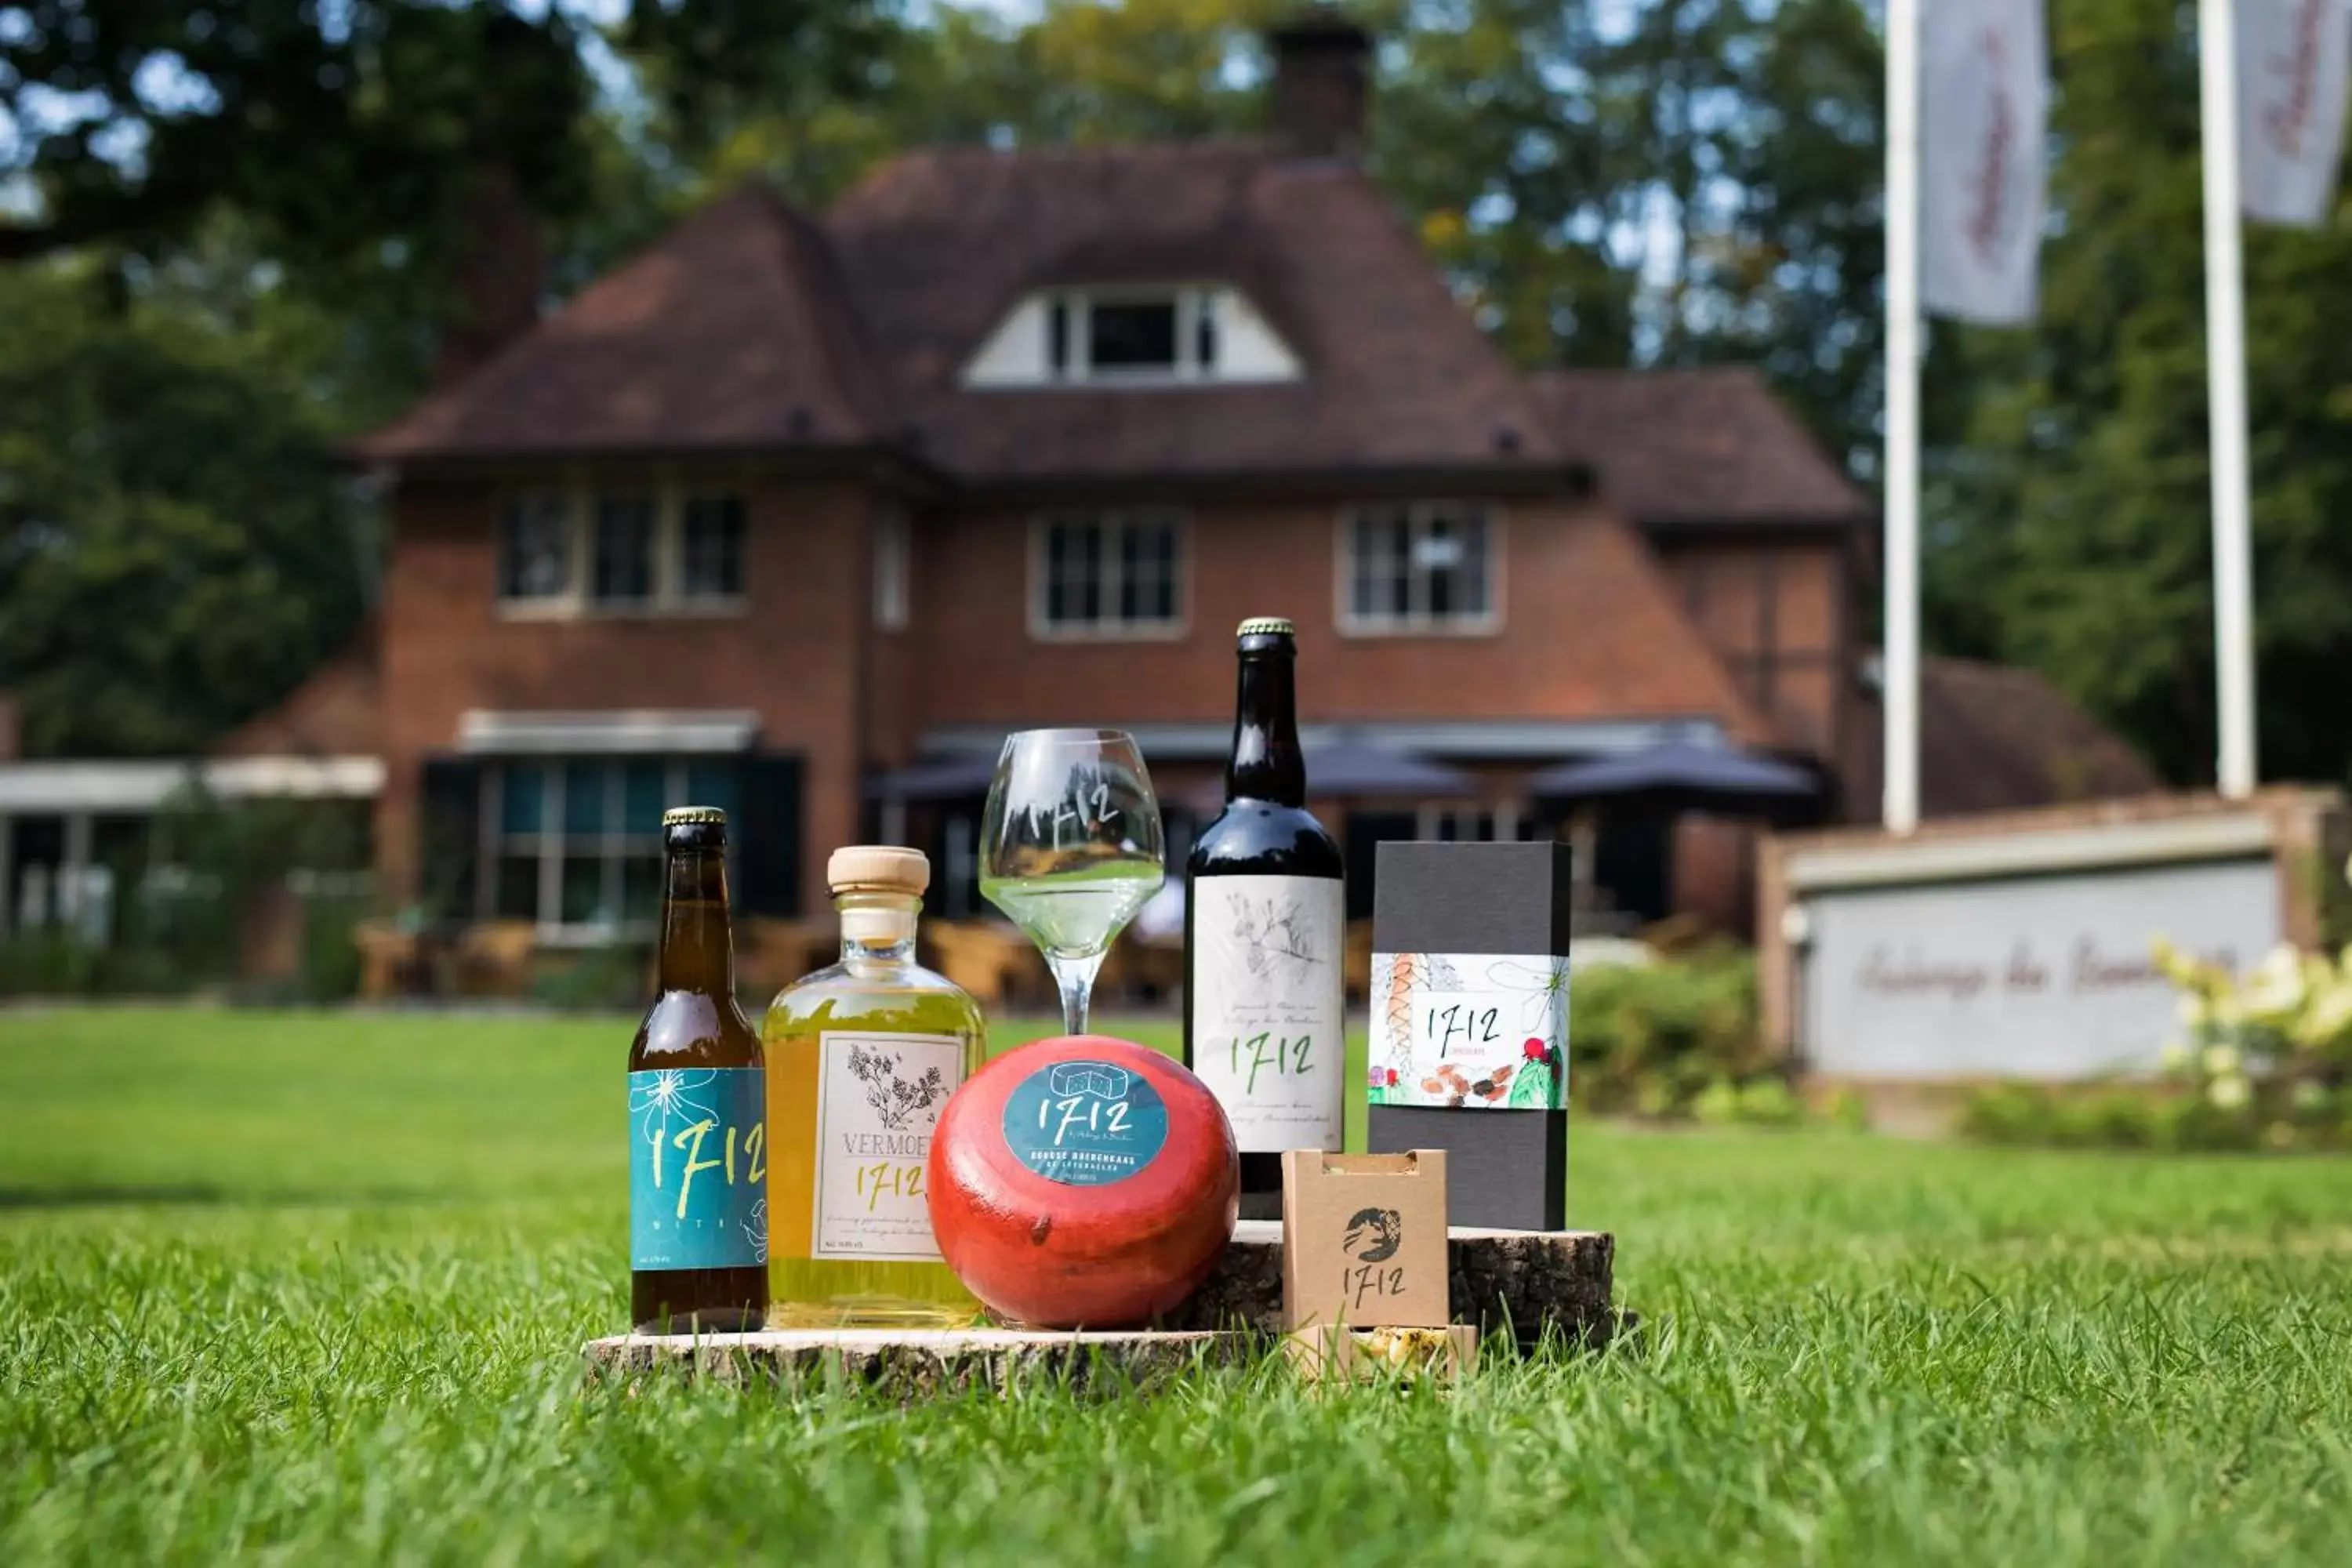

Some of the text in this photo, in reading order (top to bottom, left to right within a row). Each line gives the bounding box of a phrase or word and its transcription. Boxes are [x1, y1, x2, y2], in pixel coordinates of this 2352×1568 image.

[1427, 1004, 1501, 1059] 1712
[1232, 1031, 1316, 1095] 1712
[843, 1132, 935, 1156] VERMOE
[1038, 1095, 1134, 1146] 1712
[652, 1118, 767, 1220] 1712
[856, 1162, 924, 1213] 1712
[1343, 1264, 1406, 1310] 1712
